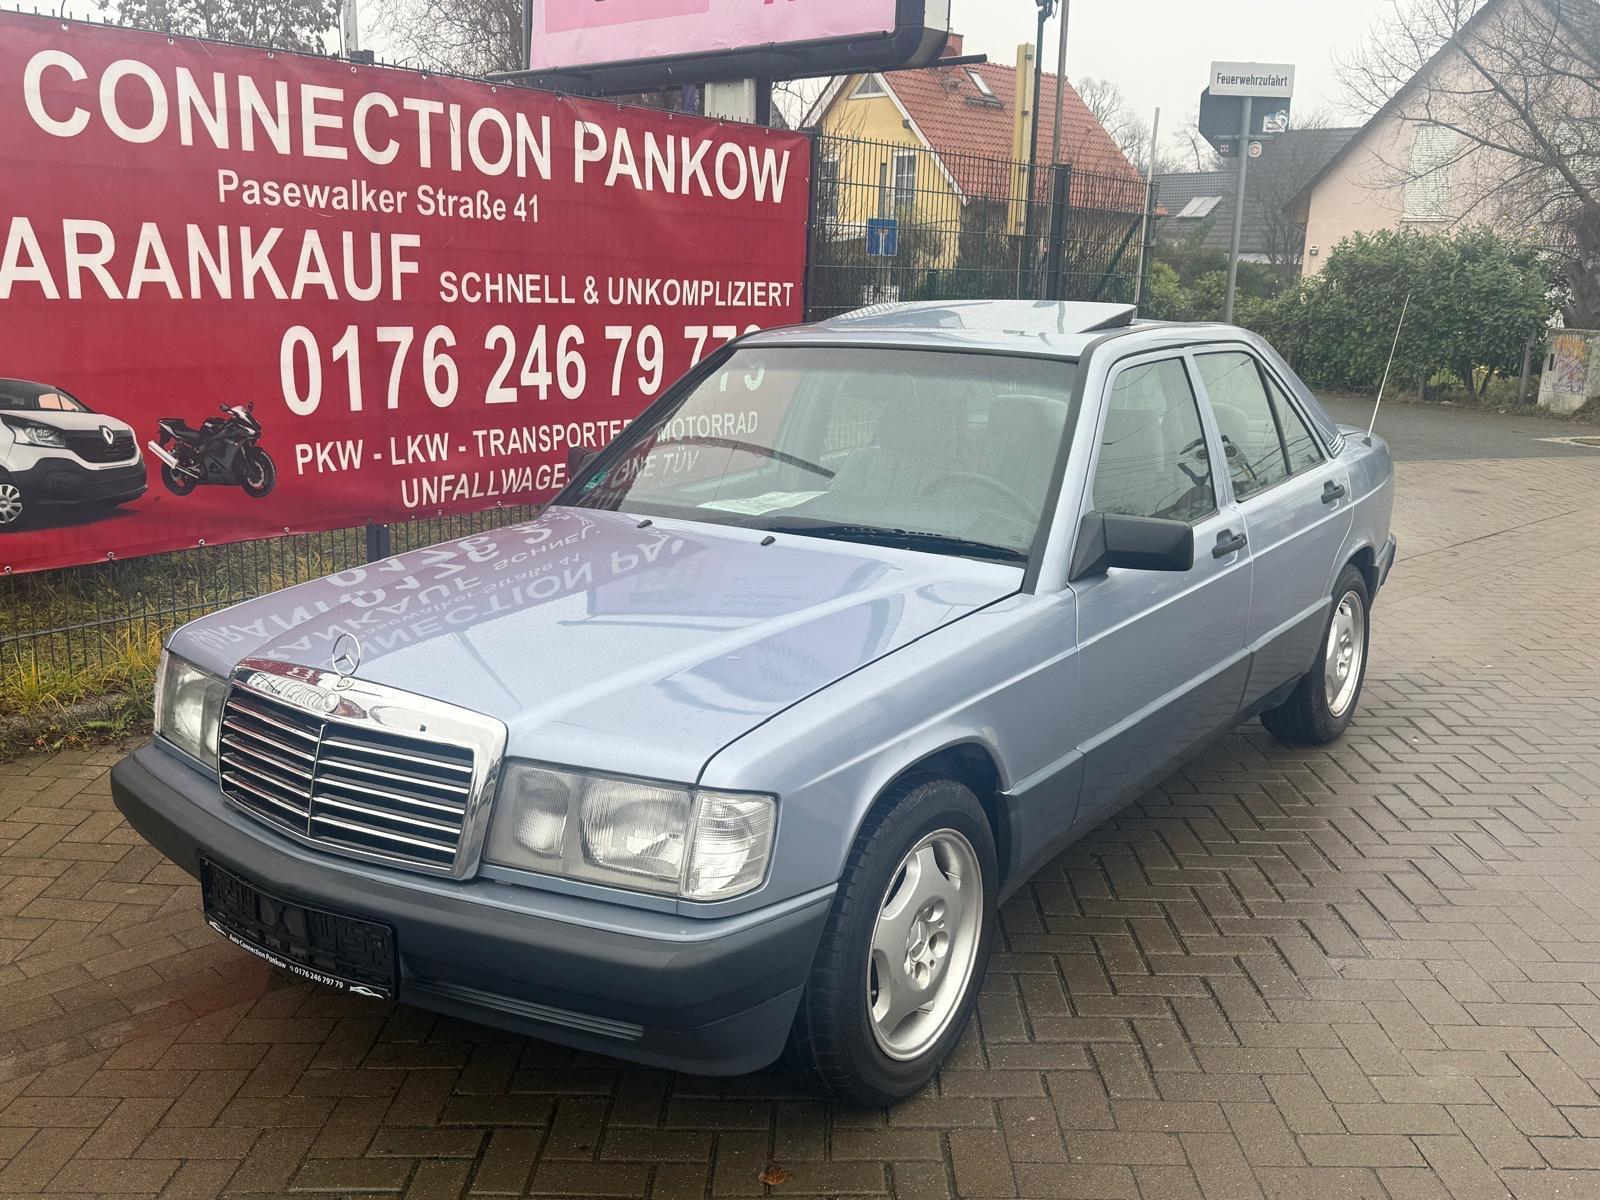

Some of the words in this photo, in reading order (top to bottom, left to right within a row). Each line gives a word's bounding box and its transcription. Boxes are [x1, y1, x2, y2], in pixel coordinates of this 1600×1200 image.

[1216, 72, 1288, 87] Feuerwehrzufahrt
[23, 49, 552, 181] CONNECTION
[573, 120, 791, 204] PANKOW
[217, 168, 408, 214] Pasewalker
[416, 184, 507, 222] Straße
[513, 192, 539, 223] 41
[439, 271, 576, 304] SCHNELL
[583, 274, 600, 305] &
[608, 276, 794, 307] UNKOMPLIZIERT
[280, 324, 459, 416] 0176
[484, 324, 586, 404] 246
[605, 324, 664, 397] 79
[295, 439, 363, 475] PKW
[390, 432, 449, 466] LKW
[472, 418, 633, 458] TRANSPORTE
[401, 462, 570, 508] UNFALLWAGE
[229, 933, 240, 945] Auto
[240, 940, 266, 959] Connection
[265, 953, 287, 969] Pankow
[294, 966, 310, 978] 0176
[309, 972, 322, 982] 246
[322, 975, 334, 986] 797
[335, 979, 344, 989] 79
